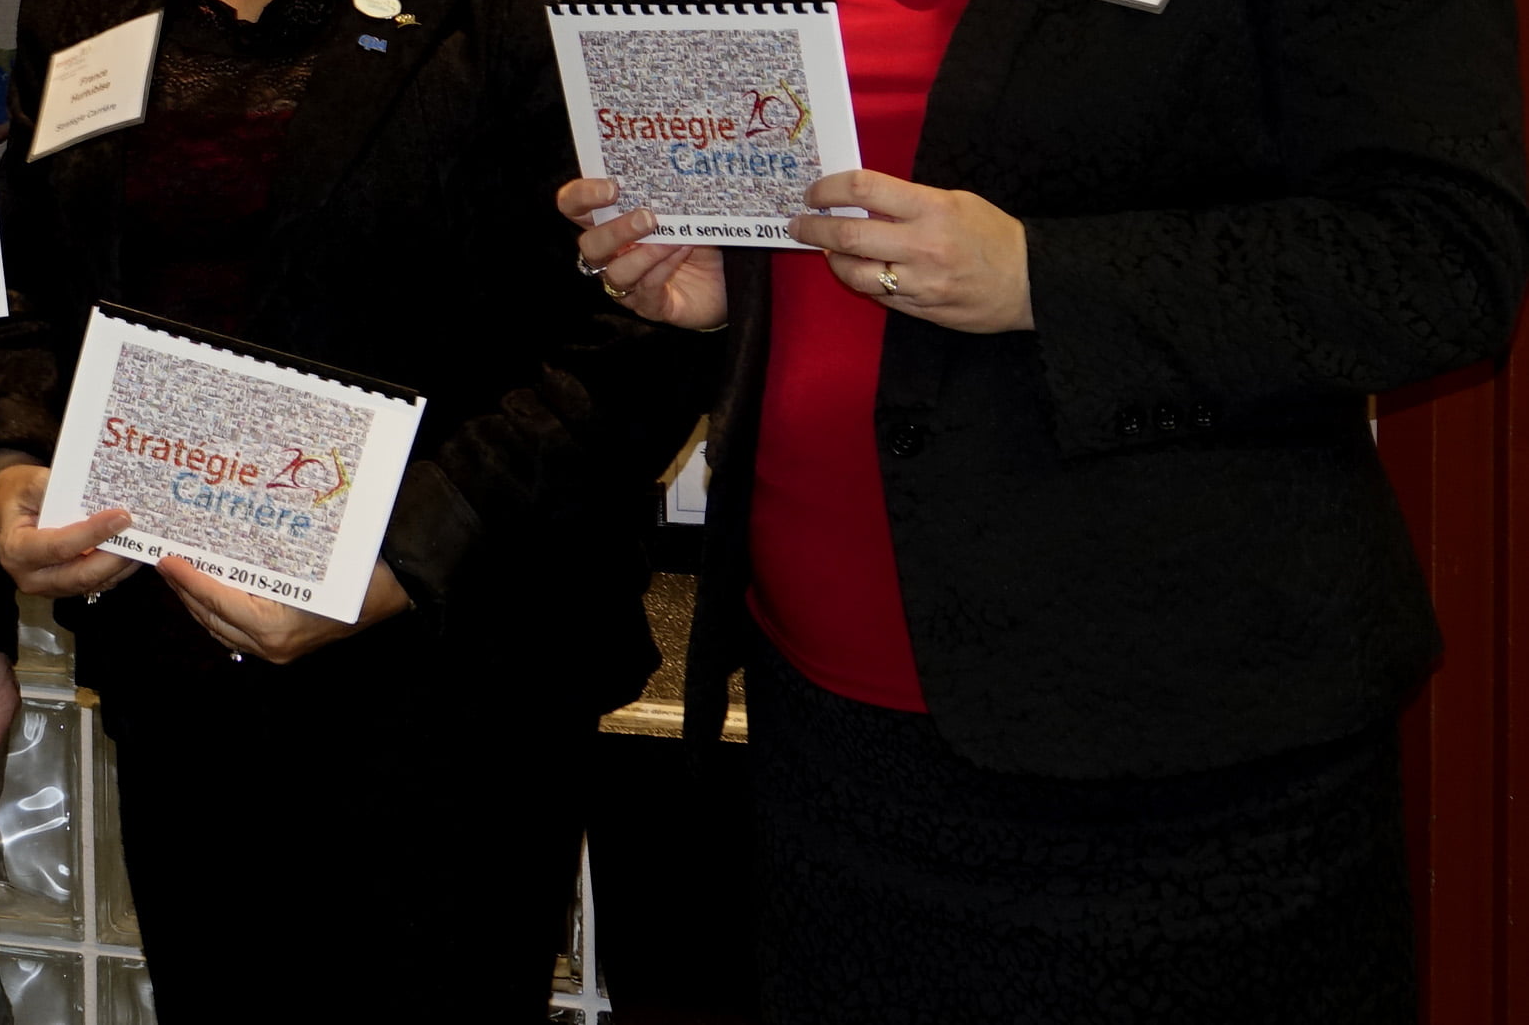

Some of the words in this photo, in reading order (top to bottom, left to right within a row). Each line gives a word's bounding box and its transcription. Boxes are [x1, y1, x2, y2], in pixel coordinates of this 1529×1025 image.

[599, 107, 735, 149] Stratégie
[670, 143, 798, 176] Carrière
[680, 224, 692, 236] et
[697, 224, 751, 237] services
[102, 417, 259, 486] Stratégie
[171, 471, 312, 538] Carrière
[148, 545, 162, 558] et
[228, 566, 312, 602] 2018-2019
